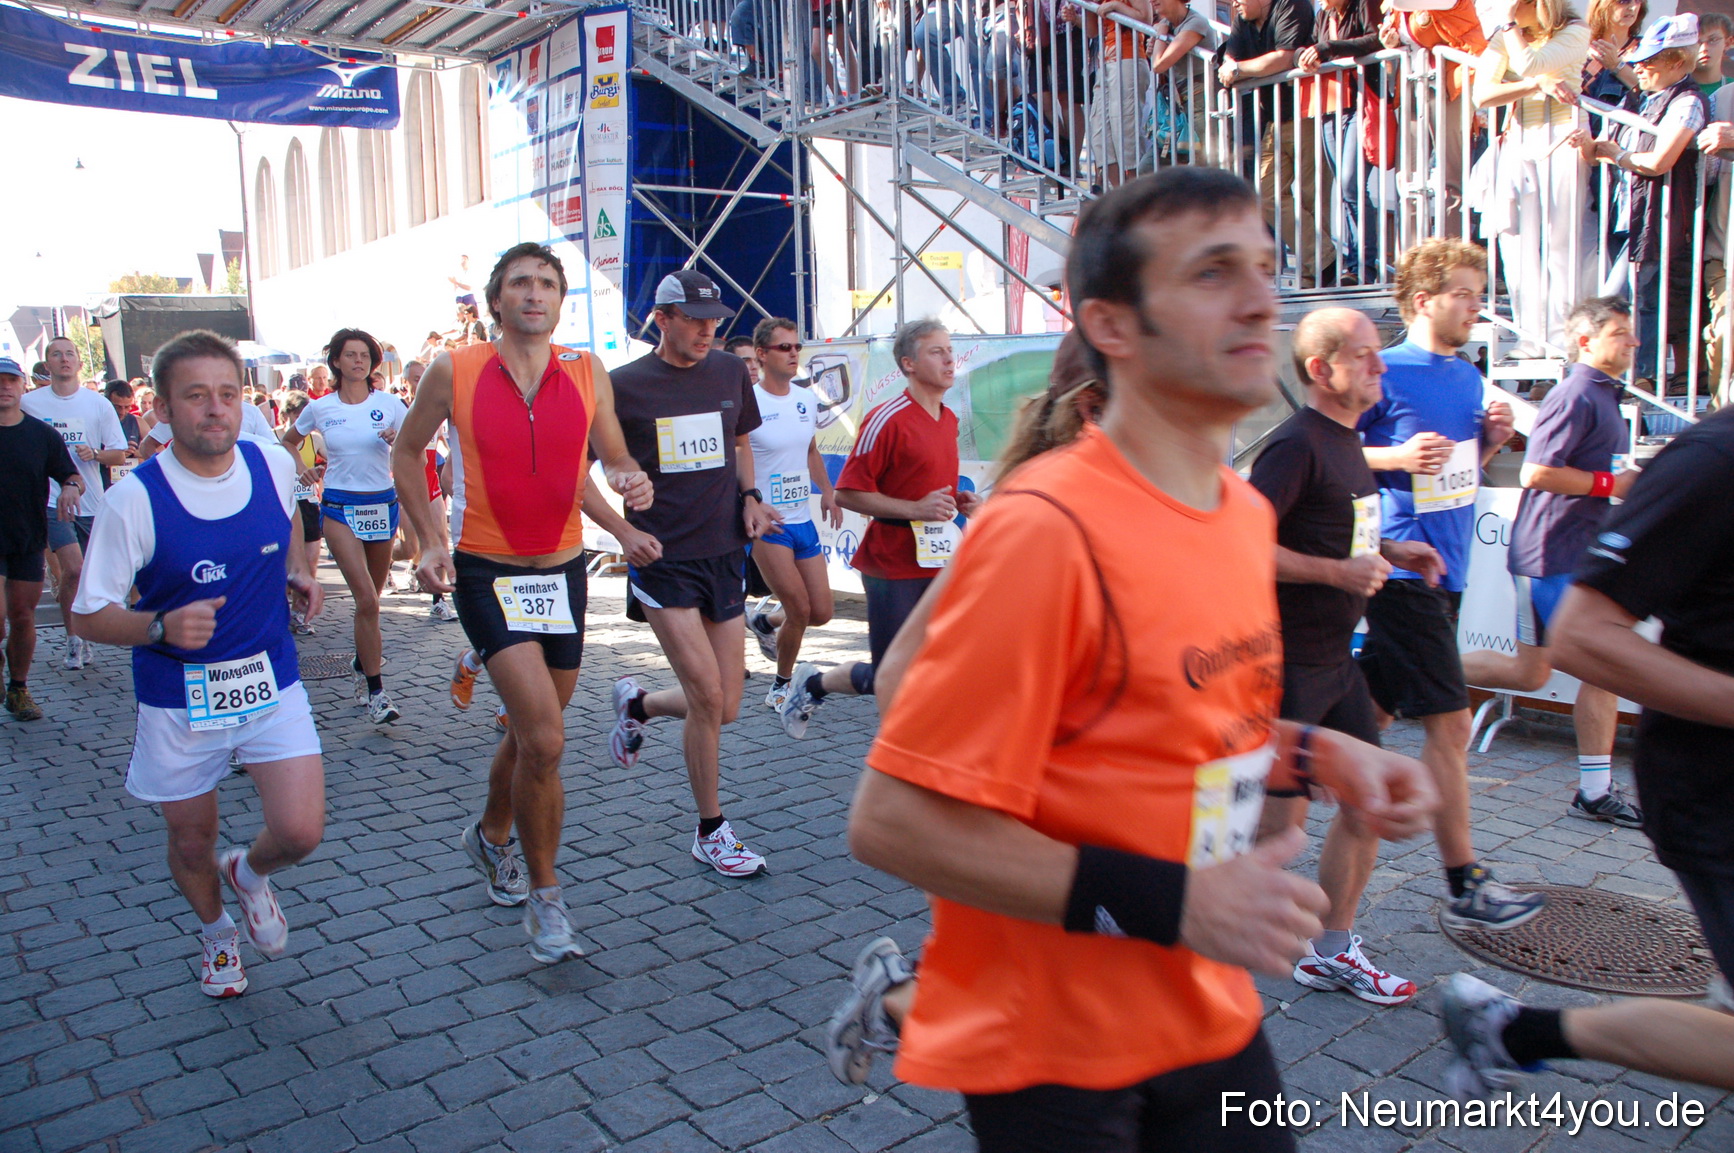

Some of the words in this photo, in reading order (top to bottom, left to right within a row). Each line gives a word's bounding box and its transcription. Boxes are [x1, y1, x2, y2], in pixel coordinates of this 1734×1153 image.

[64, 42, 218, 100] ZIEL
[309, 105, 389, 114] www.mizunoeurope.com
[62, 432, 83, 442] 087
[679, 437, 718, 455] 1103
[1437, 469, 1473, 491] 1082
[784, 485, 809, 500] 2678
[357, 519, 387, 532] 2665
[1476, 512, 1511, 547] Gu
[930, 540, 951, 553] 542
[513, 582, 559, 594] reinhard
[503, 596, 513, 605] B
[521, 598, 555, 617] 387
[191, 689, 202, 700] C
[212, 681, 272, 711] 2868
